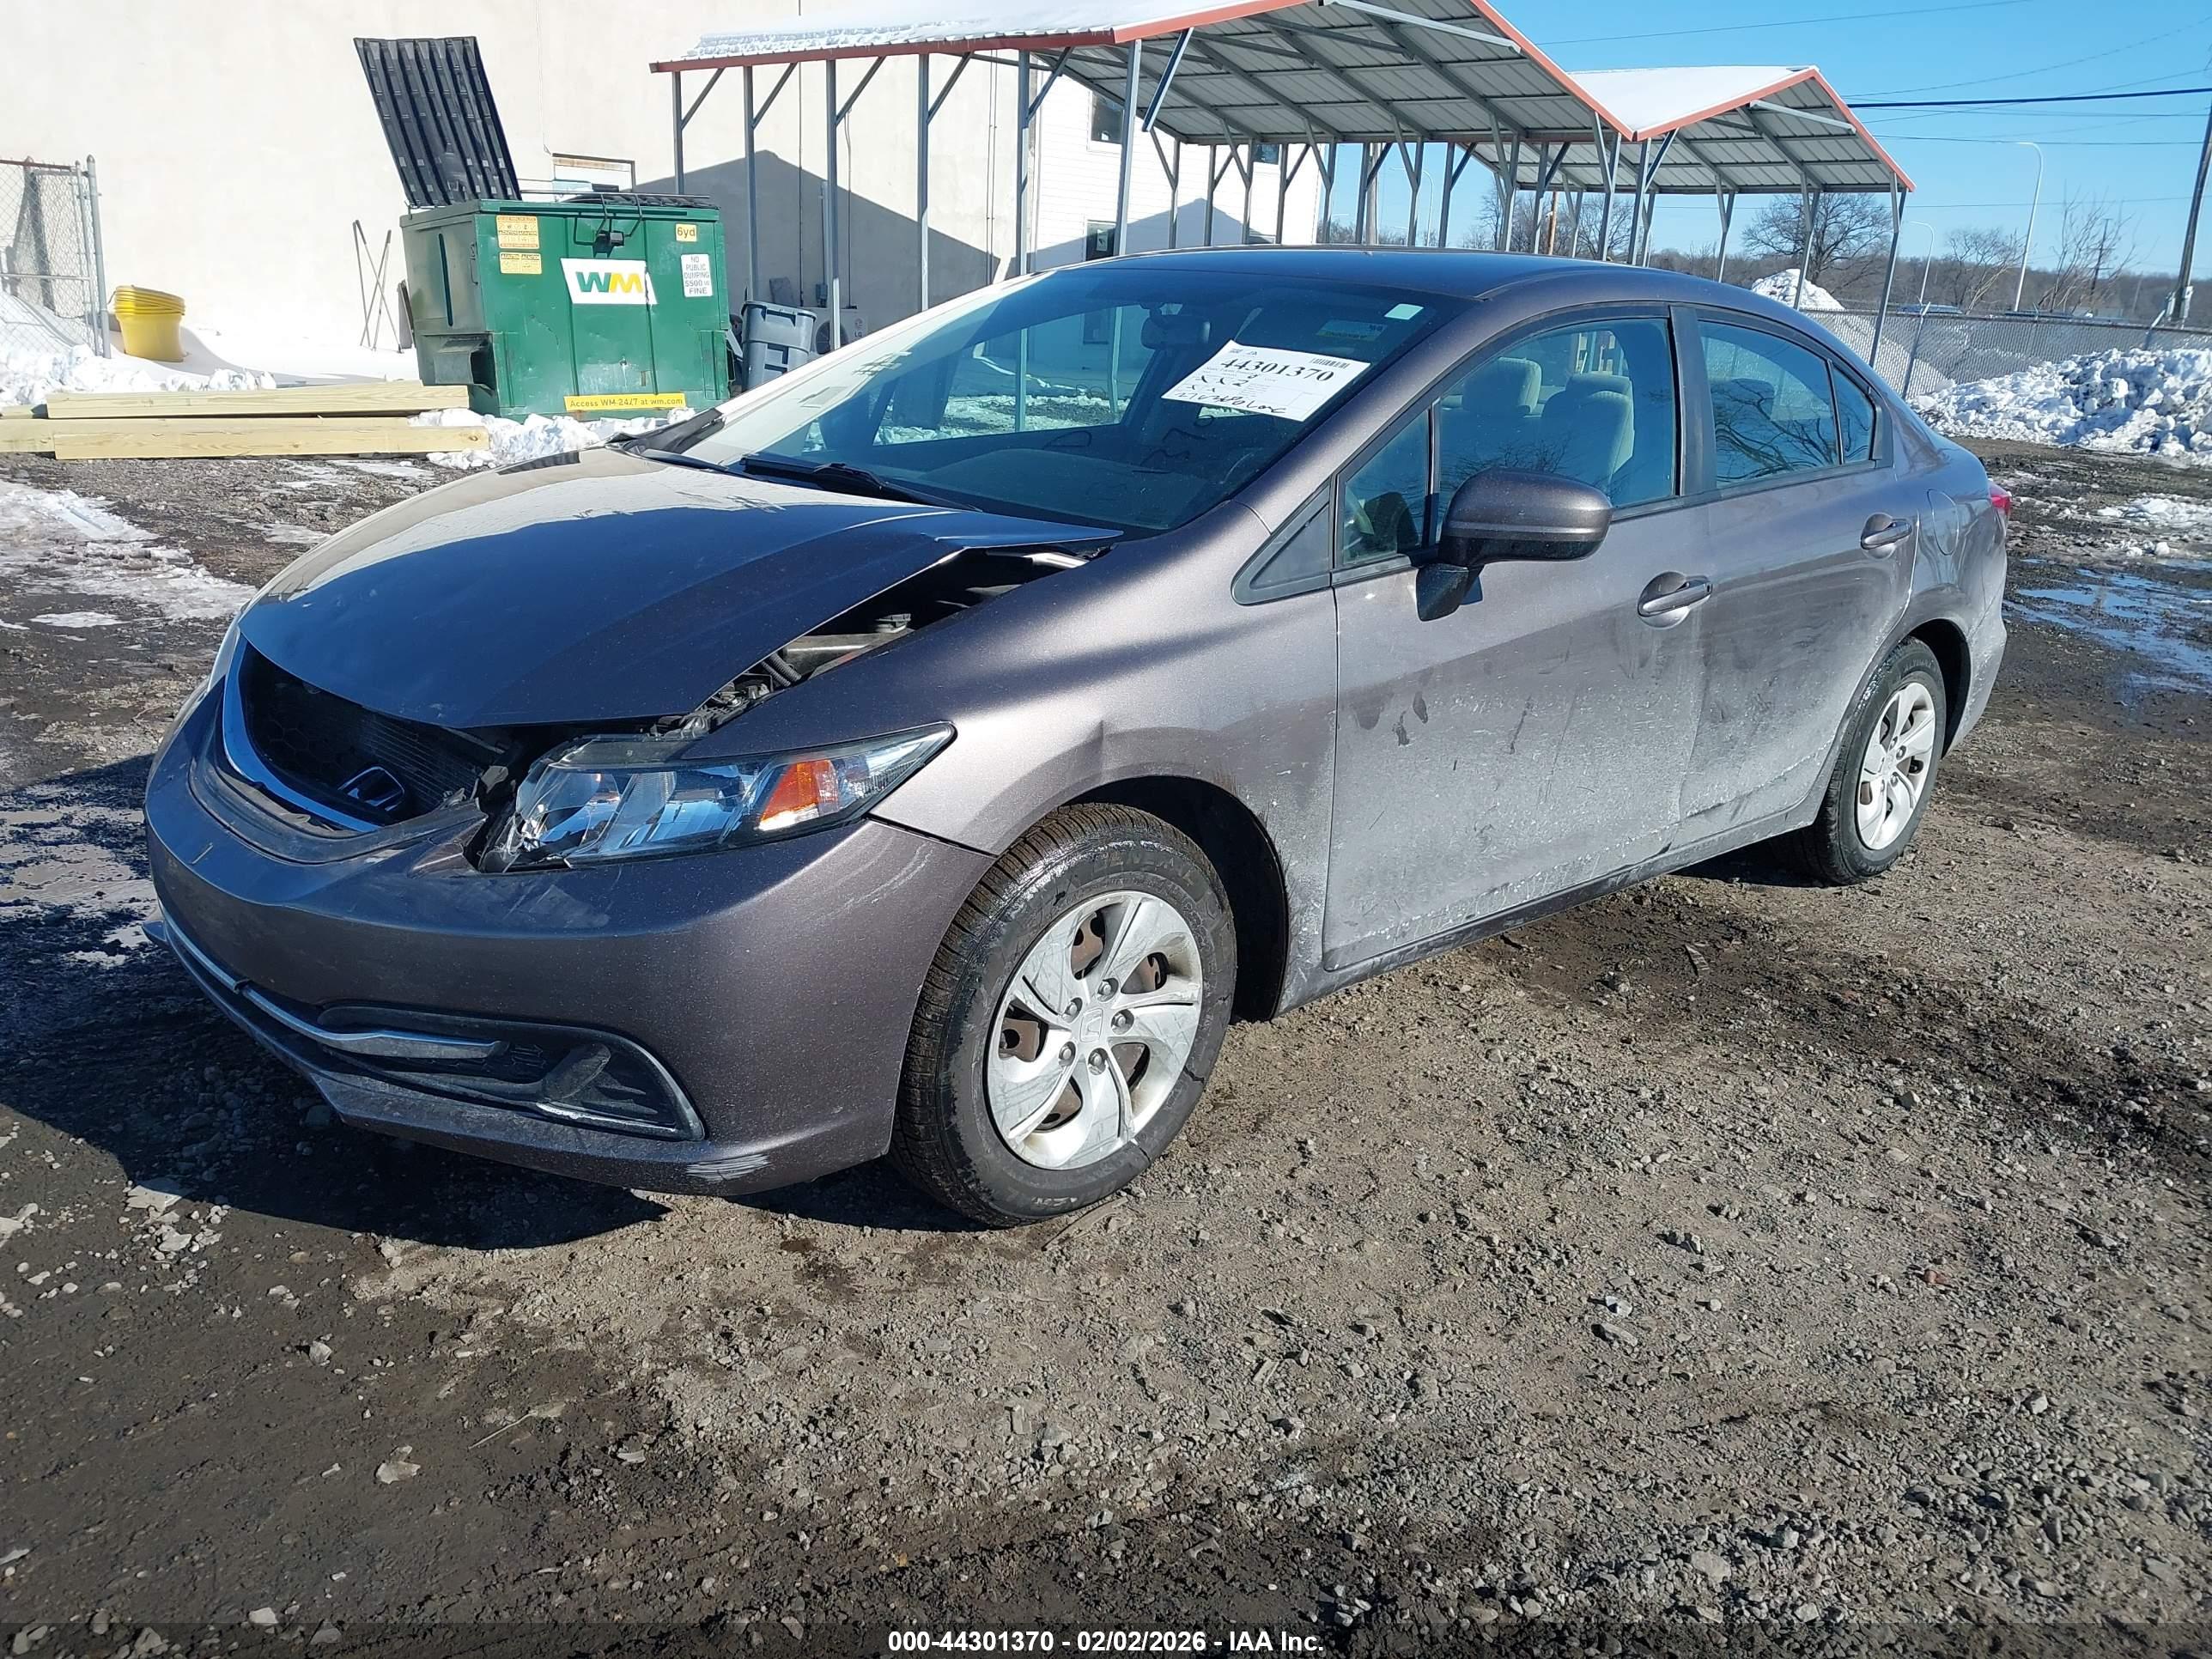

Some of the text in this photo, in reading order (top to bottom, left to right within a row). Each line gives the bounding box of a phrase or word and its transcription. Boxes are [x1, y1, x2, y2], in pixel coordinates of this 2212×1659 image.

[677, 227, 696, 239] 6yd
[684, 271, 710, 280] DUMPING
[575, 271, 644, 294] WM
[1220, 358, 1334, 382] 44301370
[569, 399, 599, 408] Access
[618, 398, 638, 406] 24/7
[650, 397, 684, 405] wm.com
